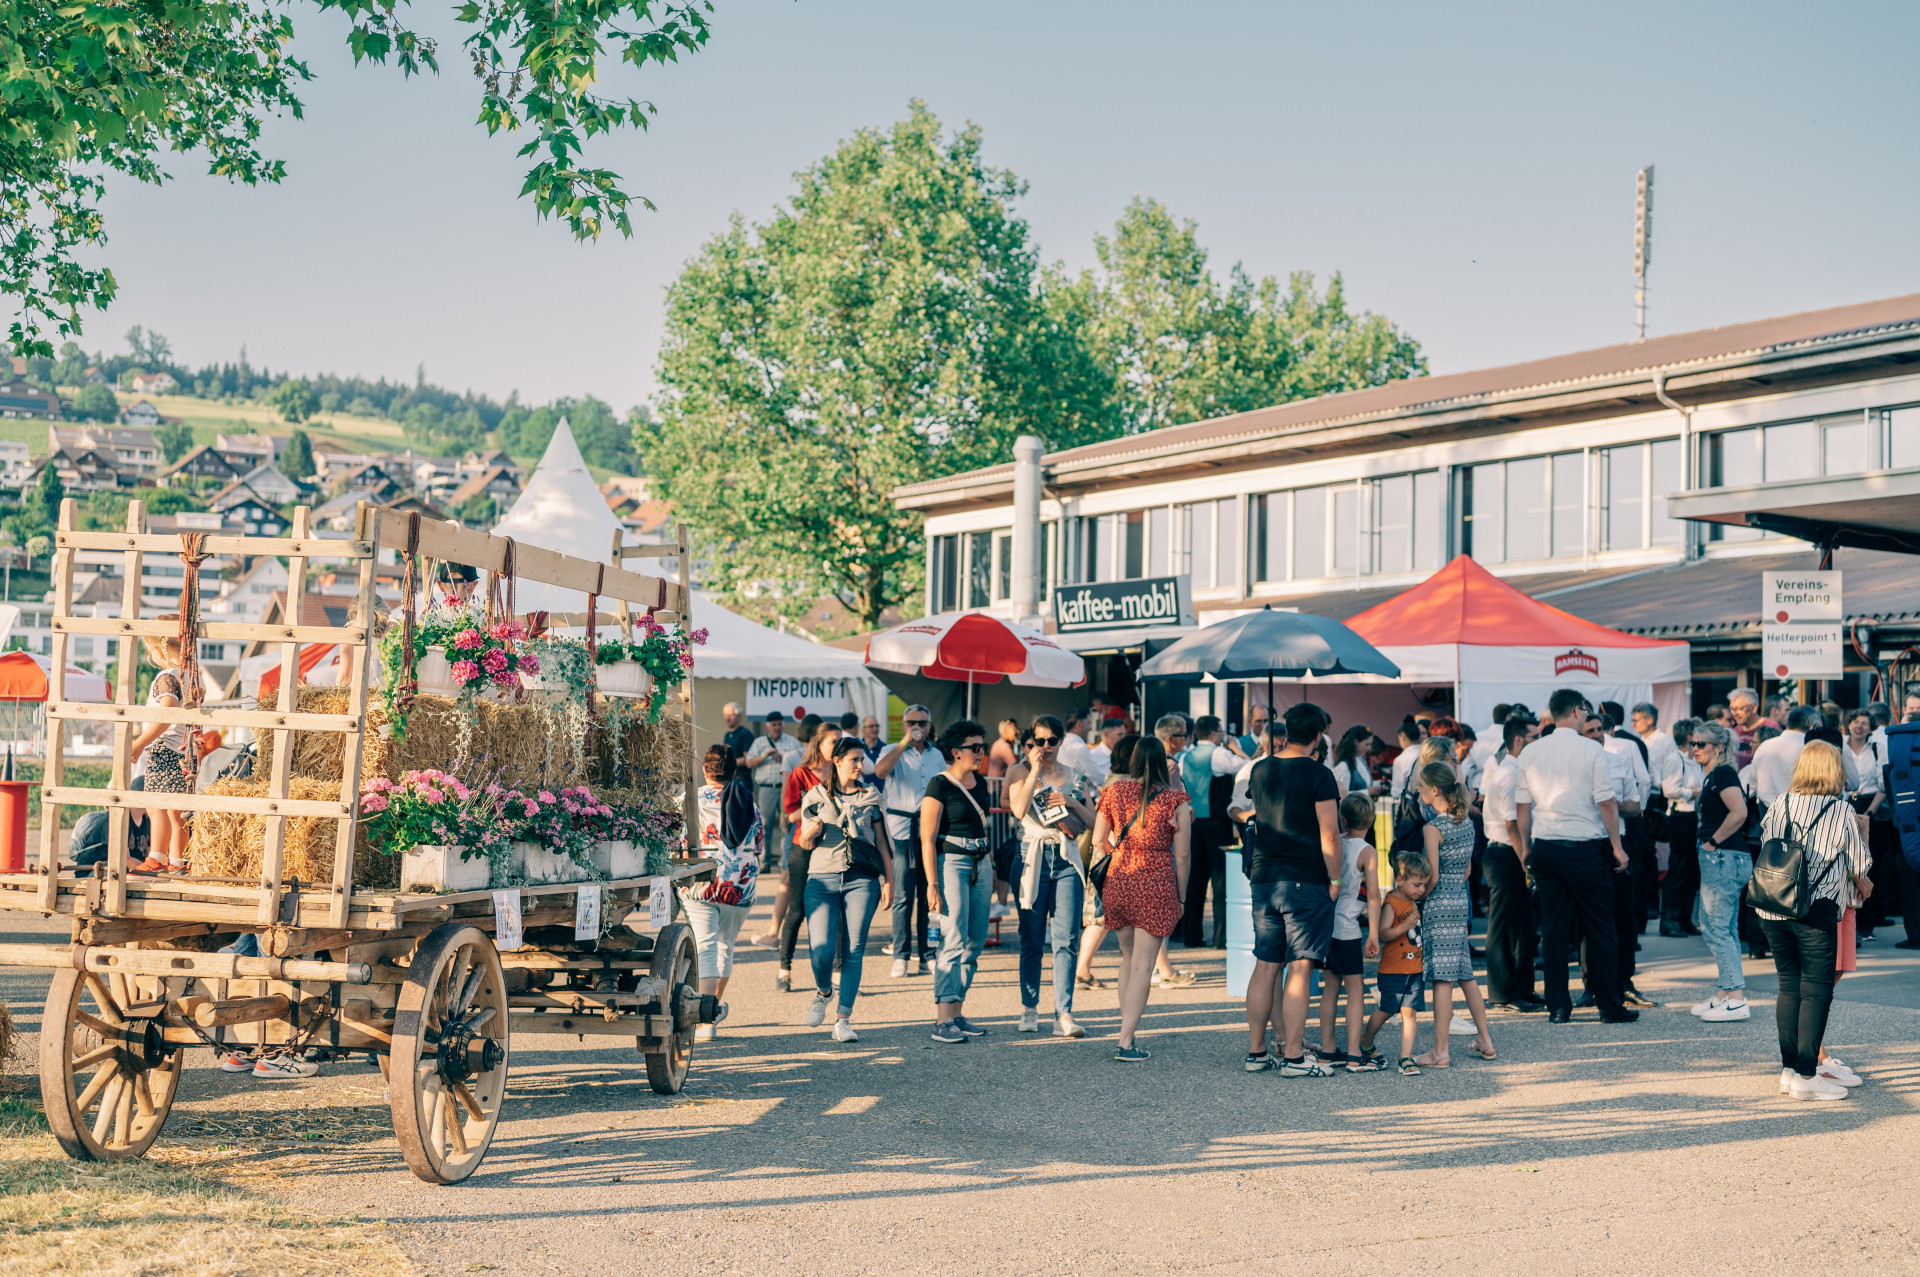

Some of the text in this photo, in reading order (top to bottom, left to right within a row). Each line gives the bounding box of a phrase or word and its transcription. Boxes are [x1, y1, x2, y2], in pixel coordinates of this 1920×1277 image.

[1775, 579, 1829, 590] Vereins-
[1056, 581, 1177, 624] kaffee-mobil
[1775, 593, 1831, 605] Empfang
[1767, 633, 1837, 643] Helferpoint 1
[1781, 648, 1816, 656] Infopoint
[752, 679, 845, 698] INFOPOINT 1
